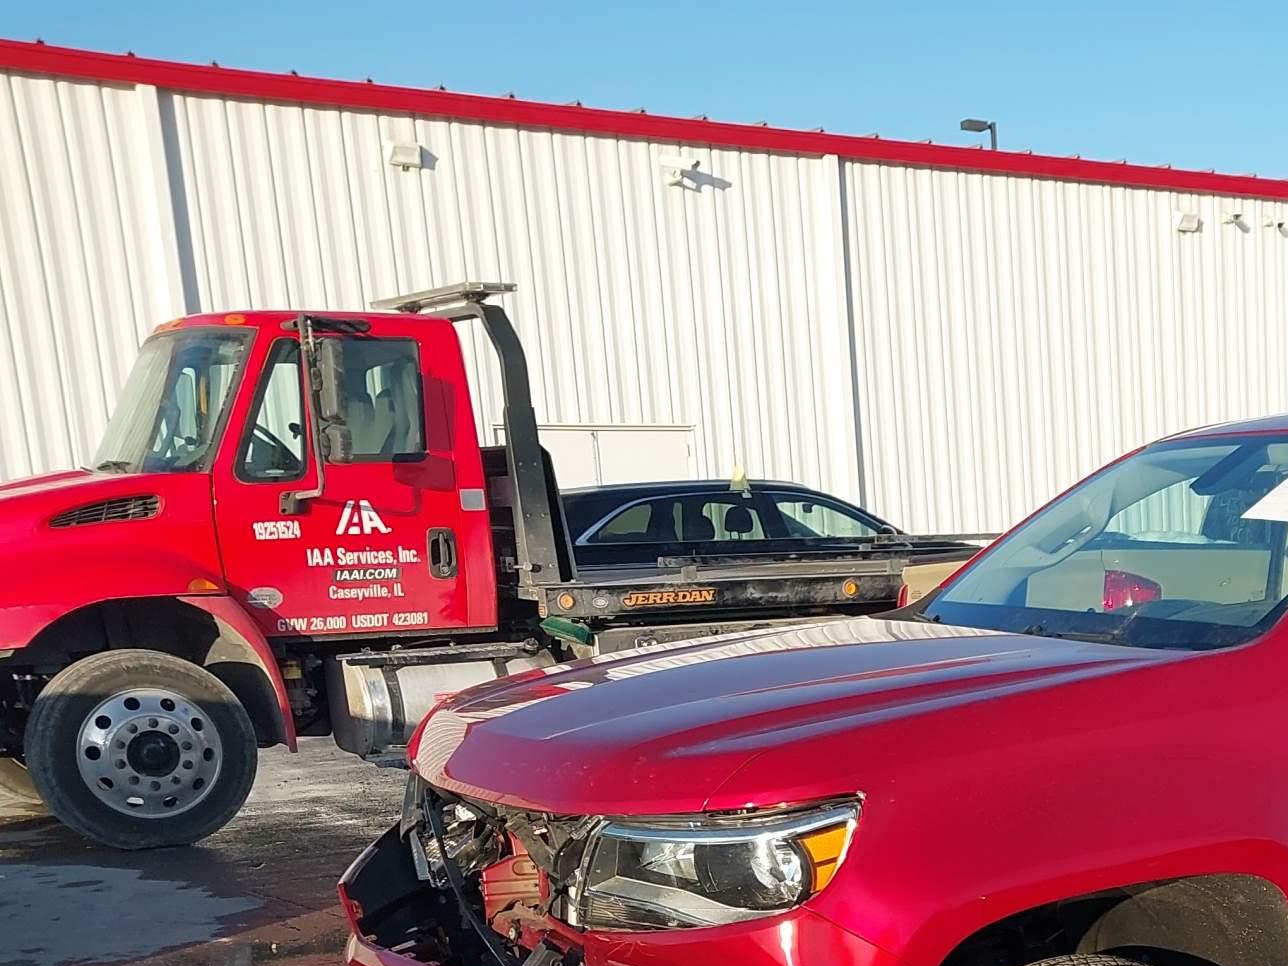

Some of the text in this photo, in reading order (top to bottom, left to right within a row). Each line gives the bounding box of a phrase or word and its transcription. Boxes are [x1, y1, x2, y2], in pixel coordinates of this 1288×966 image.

[252, 520, 301, 540] 19251524
[306, 546, 421, 567] IAA Services, Inc.
[336, 568, 397, 581] IAAI.COM
[329, 583, 405, 603] Caseyville, IL
[277, 611, 429, 632] GVW 26,000 USDOT 423081
